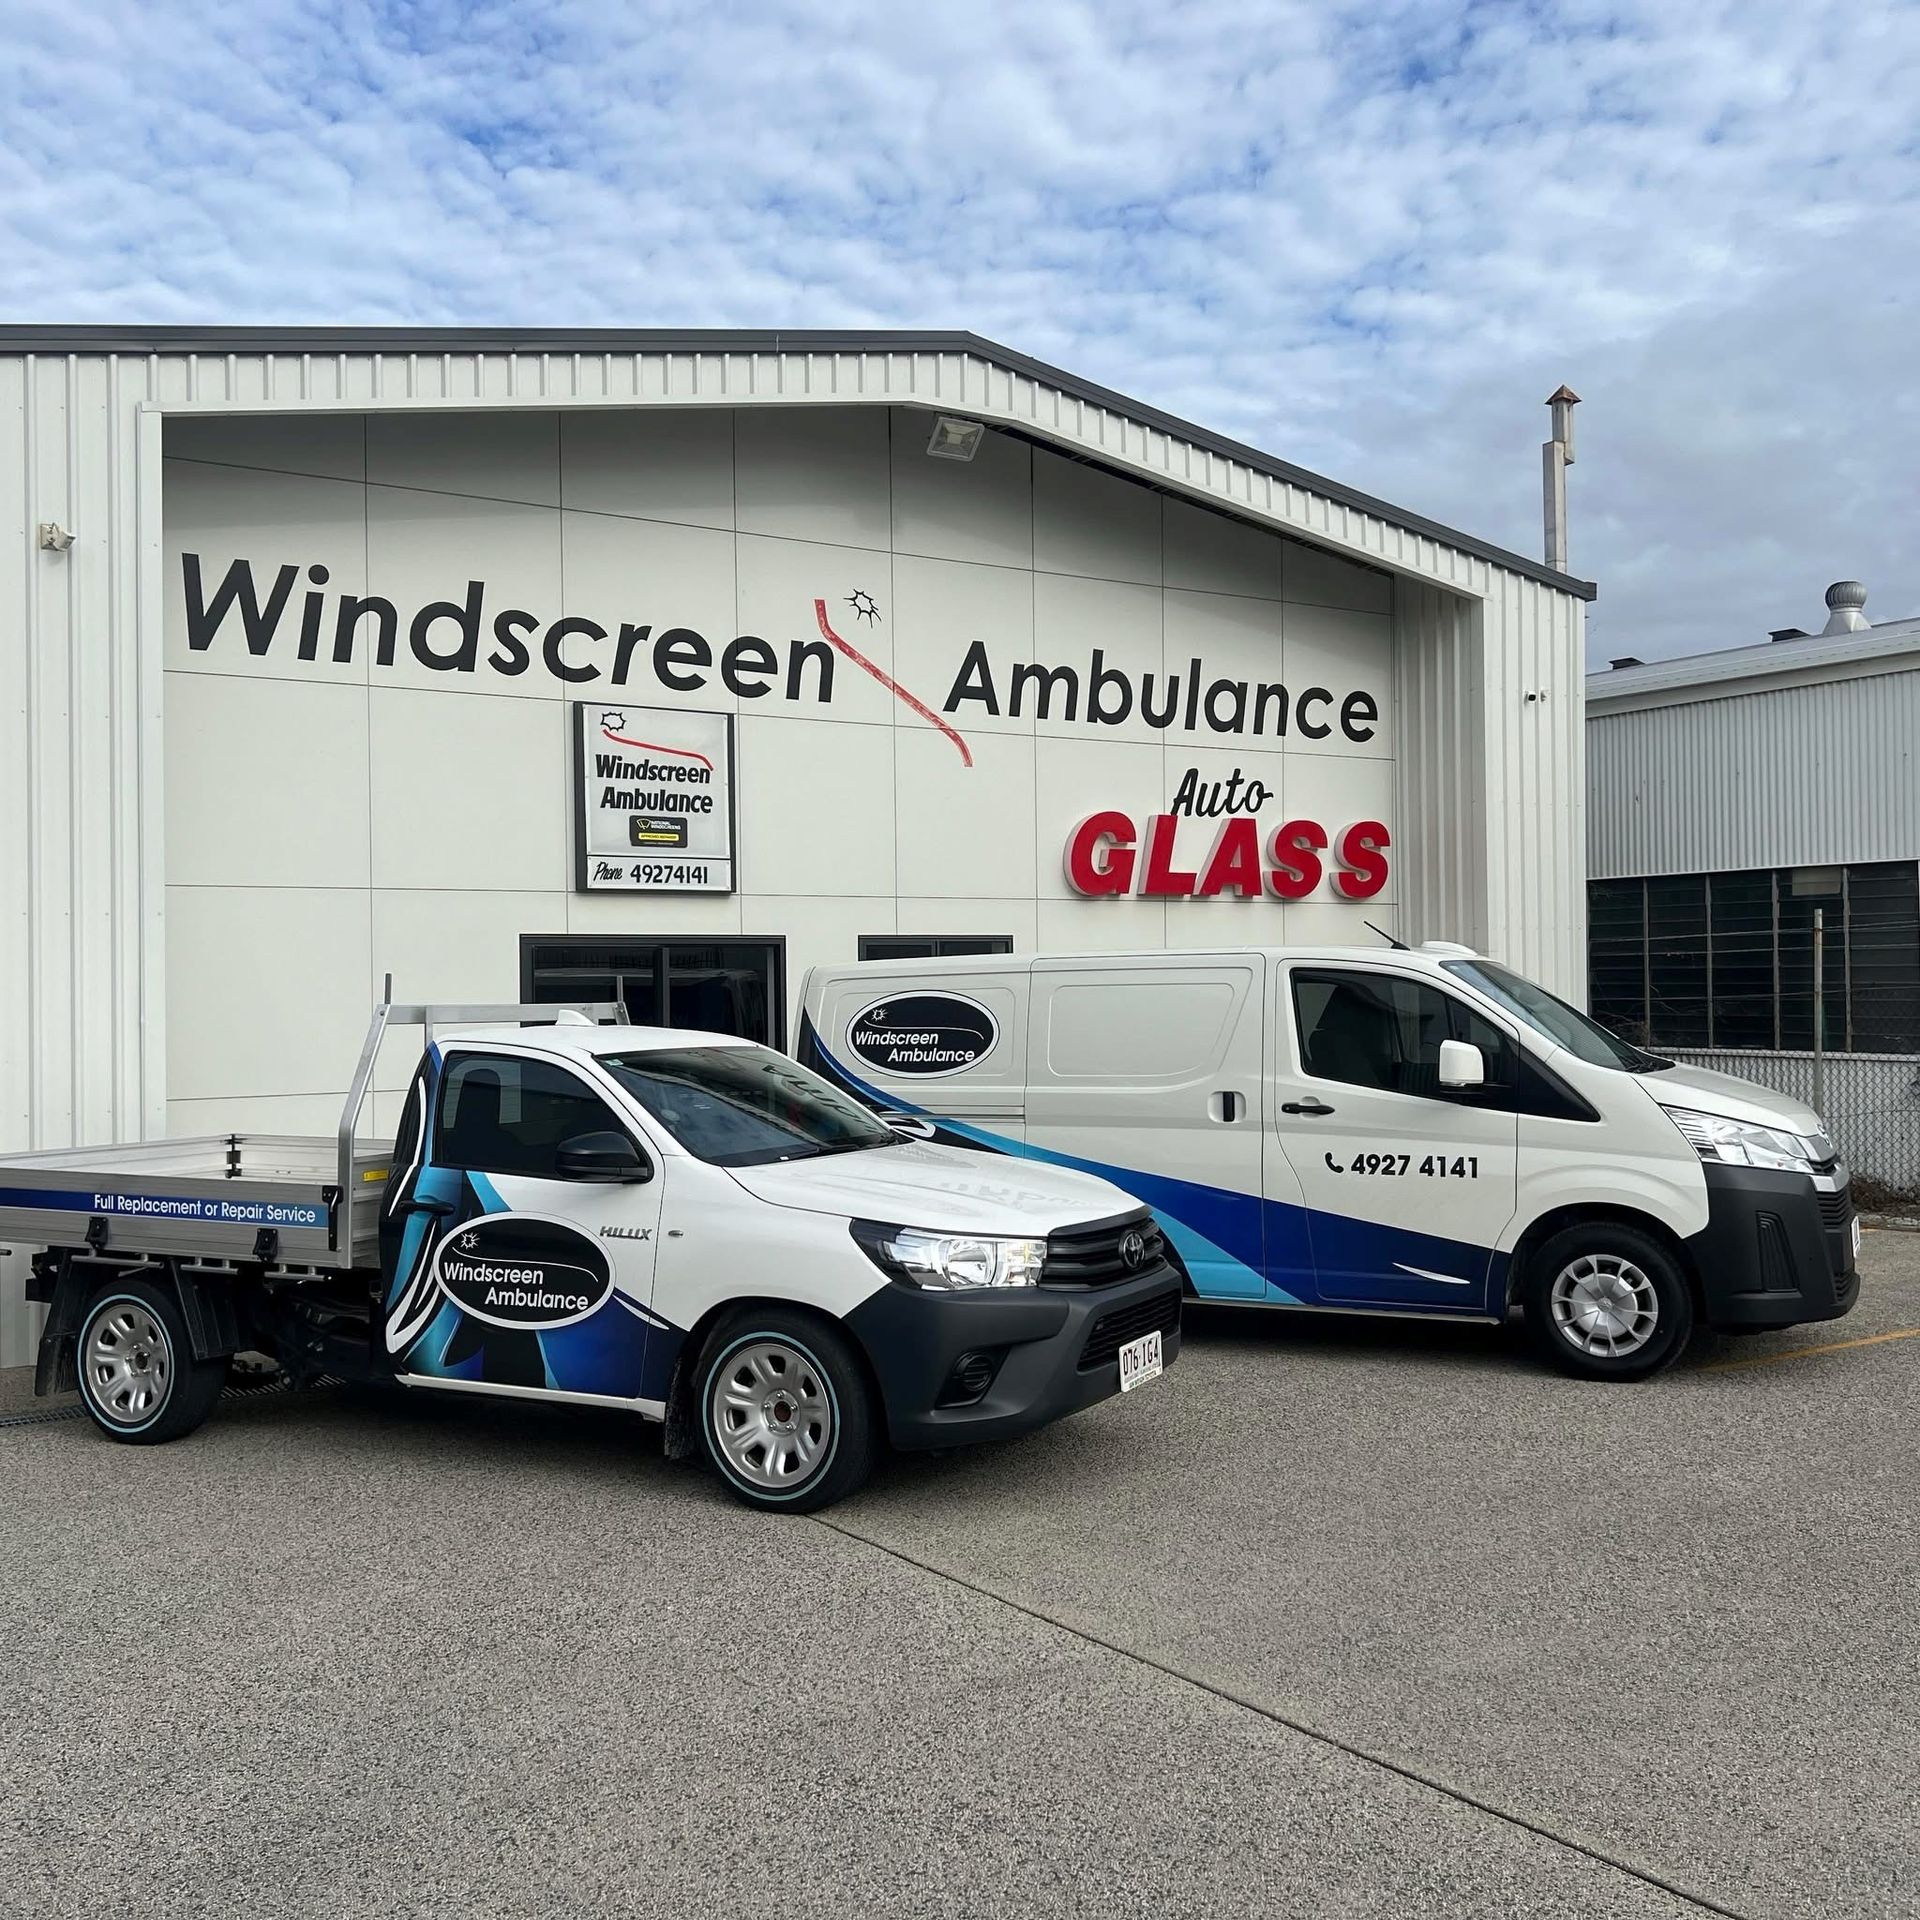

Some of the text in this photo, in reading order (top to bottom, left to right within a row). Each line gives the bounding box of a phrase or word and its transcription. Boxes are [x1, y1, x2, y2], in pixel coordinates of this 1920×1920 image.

[181, 552, 1379, 743] Windscreen Ambulance
[595, 754, 711, 784] Windscreen
[600, 786, 713, 814] Ambulance
[1170, 768, 1274, 818] Auto
[1064, 811, 1391, 900] GLASS
[593, 861, 708, 884] Phone 49274141
[855, 1031, 939, 1046] Windscreen
[887, 1047, 975, 1062] Ambulance
[1351, 1153, 1478, 1179] 4927 4141
[94, 1194, 316, 1223] Full Replacement or Repair Service
[600, 1225, 653, 1241] HILUX
[444, 1262, 544, 1285] Windscreen
[484, 1287, 589, 1310] Ambulance
